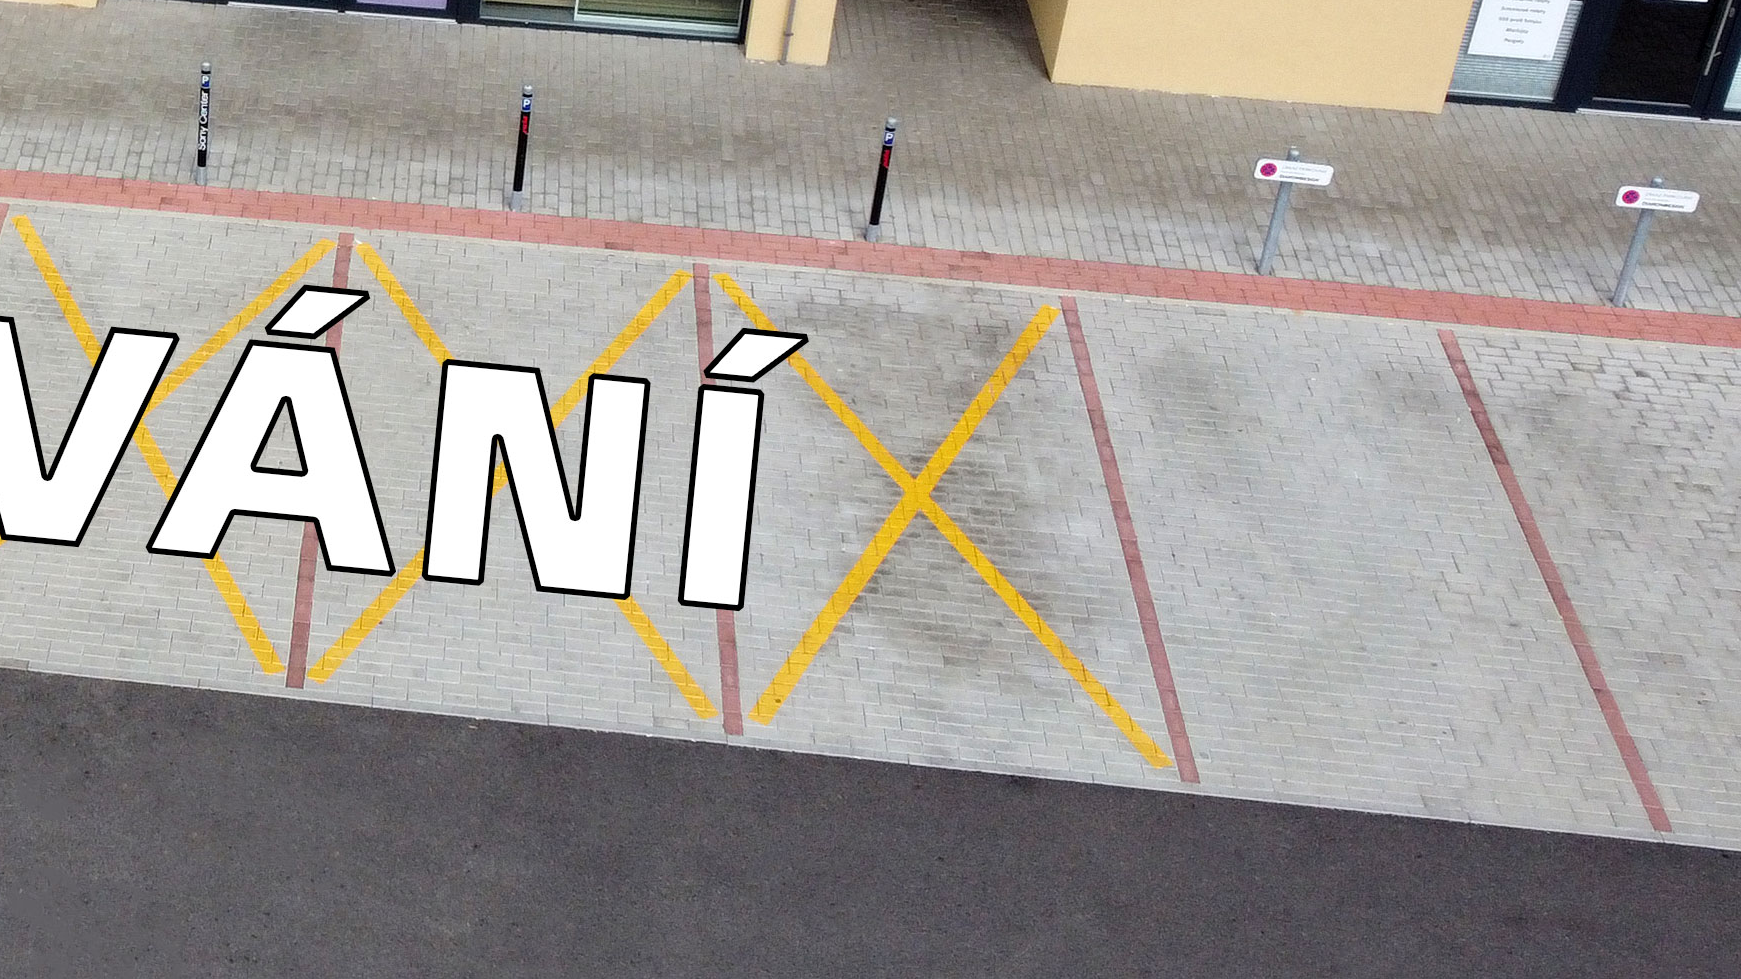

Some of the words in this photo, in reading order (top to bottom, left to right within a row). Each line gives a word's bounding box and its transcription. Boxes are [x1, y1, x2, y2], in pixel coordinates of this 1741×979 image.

[202, 75, 209, 84] P
[200, 90, 209, 125] Center
[523, 99, 531, 108] P
[198, 125, 209, 151] Sony
[885, 132, 894, 142] P
